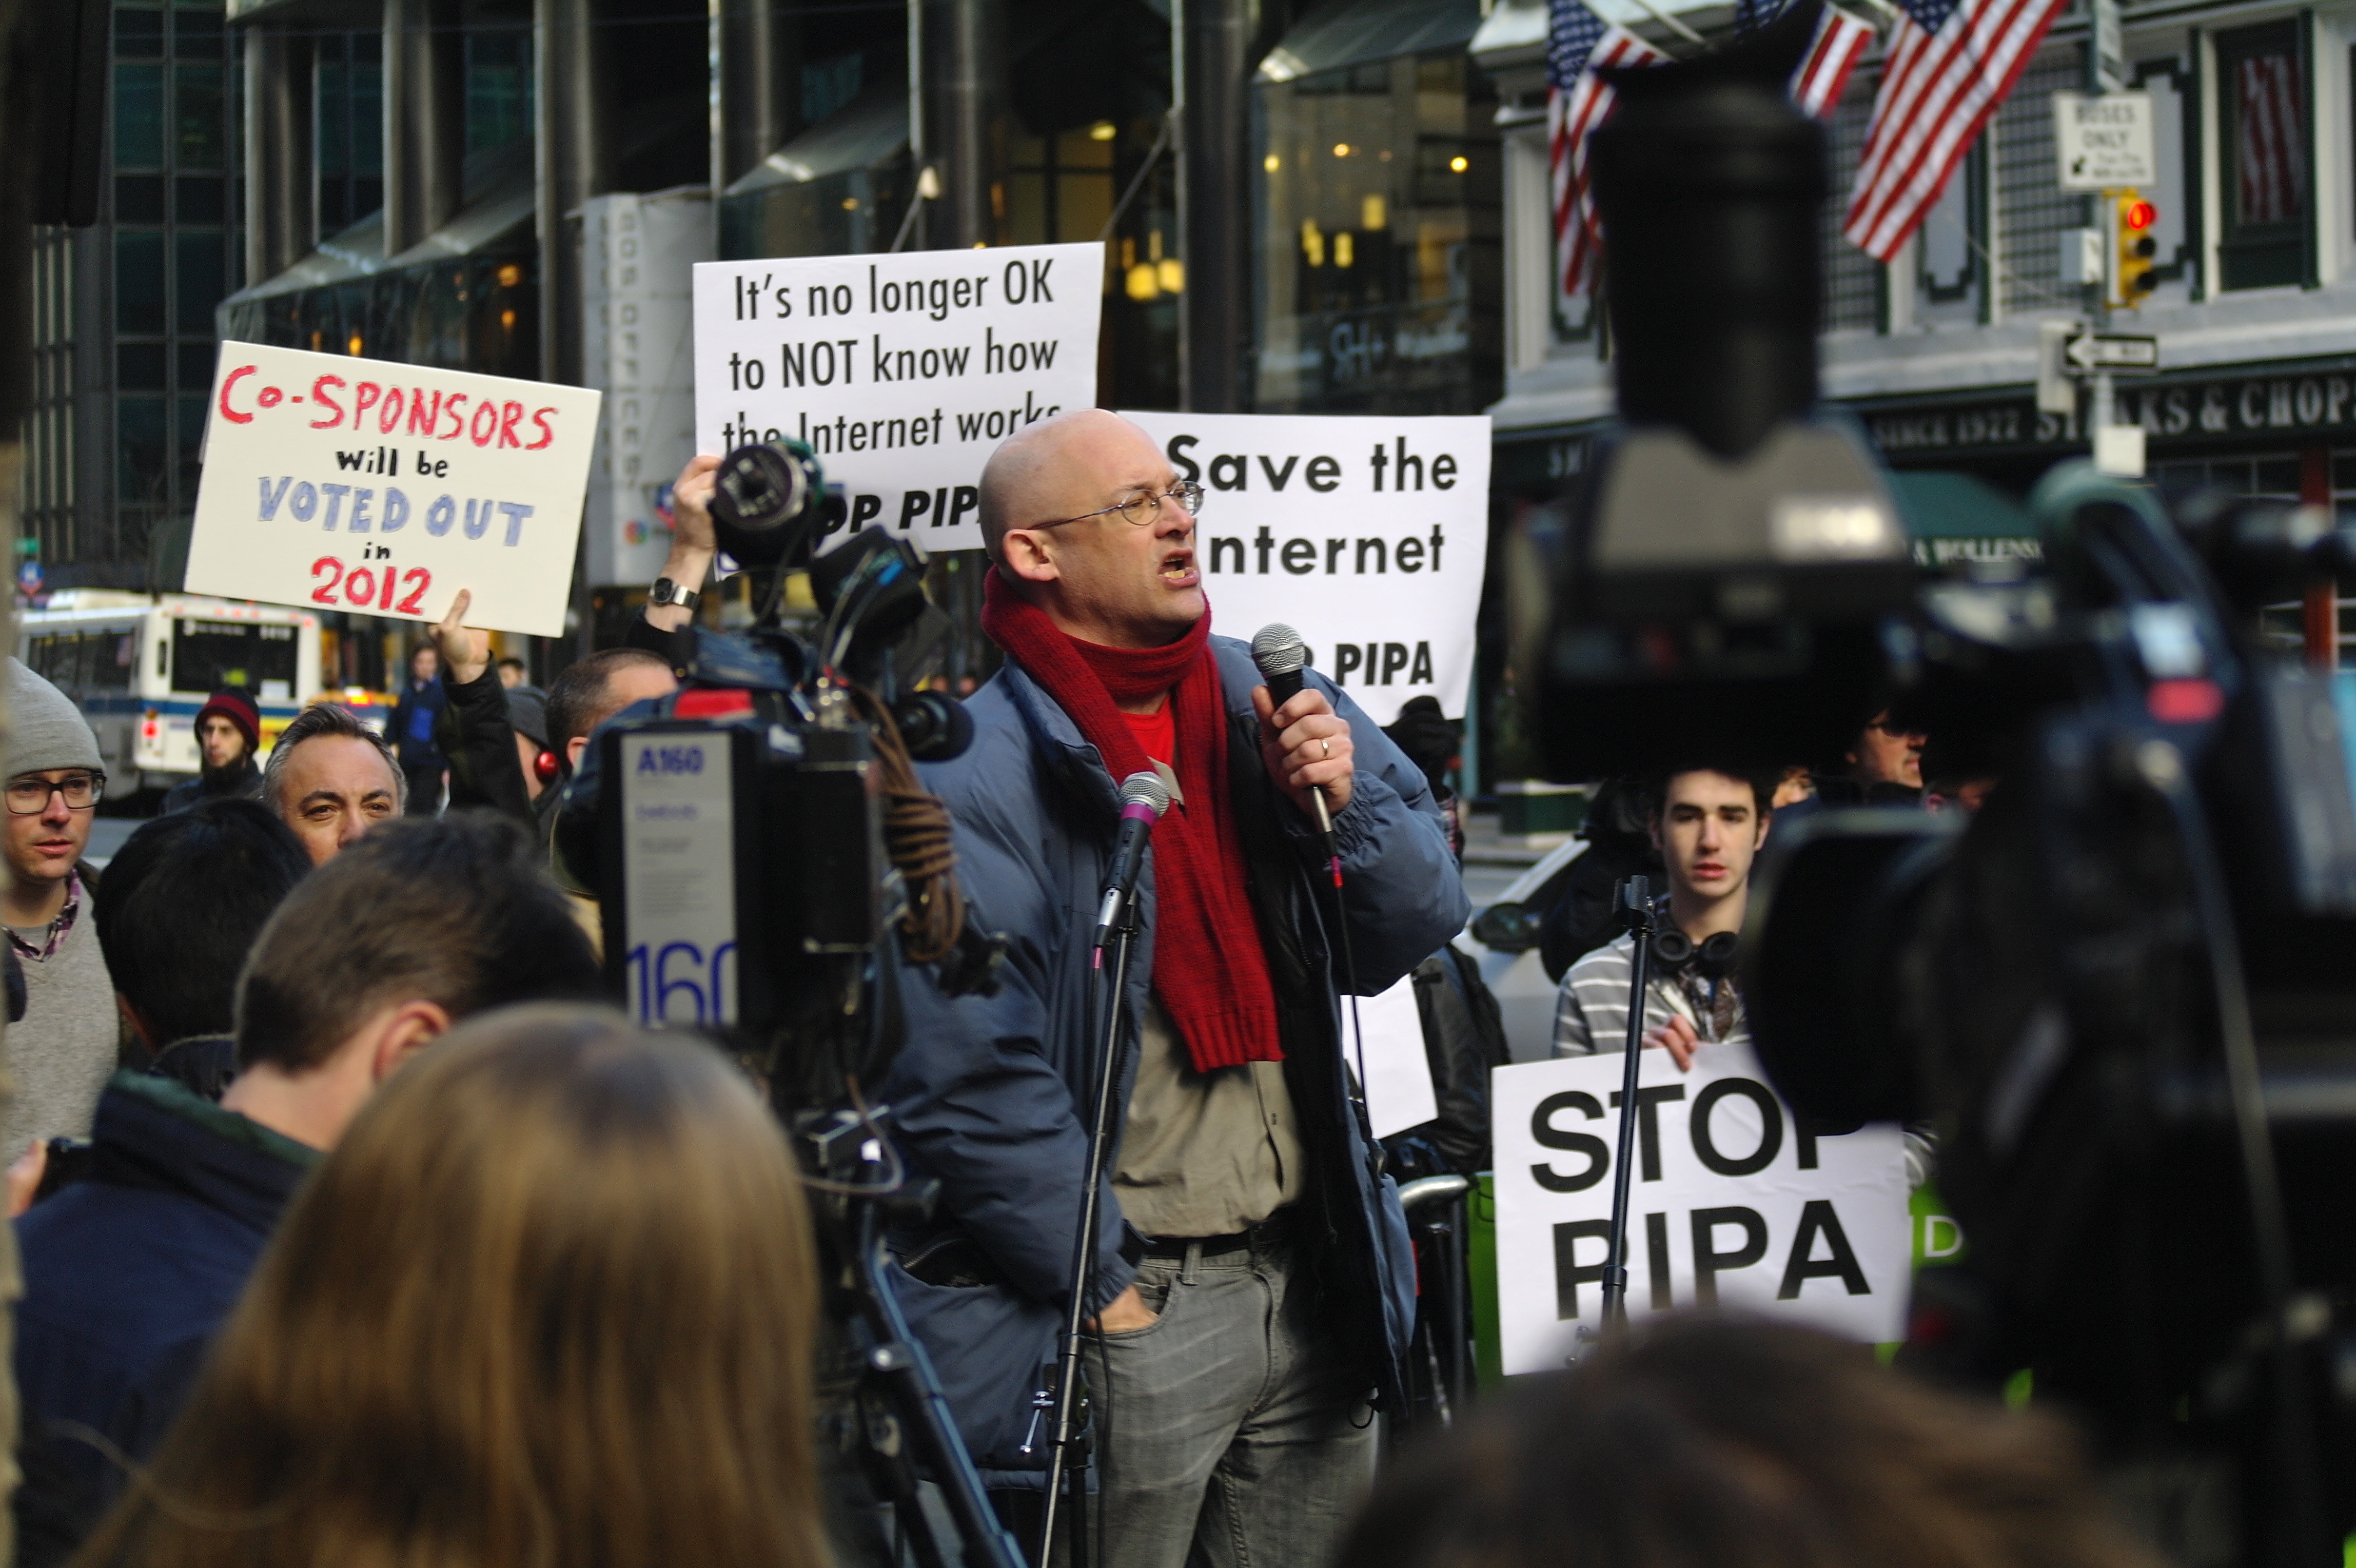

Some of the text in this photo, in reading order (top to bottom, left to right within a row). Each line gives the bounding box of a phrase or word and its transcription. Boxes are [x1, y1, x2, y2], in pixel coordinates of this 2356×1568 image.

[735, 259, 1054, 322] It's no longer OK
[729, 327, 1058, 391] to NOT know how
[799, 408, 942, 455] Internet
[2035, 389, 2192, 443] STAKS
[2239, 377, 2356, 429] CHOP
[336, 447, 448, 478] will be
[1167, 434, 1458, 494] Save the
[258, 476, 534, 547] VOTED OUT
[898, 485, 980, 529] PIP
[363, 542, 390, 560] in
[1193, 519, 1445, 575] nternet
[311, 556, 432, 615] 2012
[1335, 641, 1435, 687] PIPA
[636, 745, 706, 776] A160
[1528, 1076, 1819, 1193] STO
[1552, 1199, 1872, 1321] PIPA
